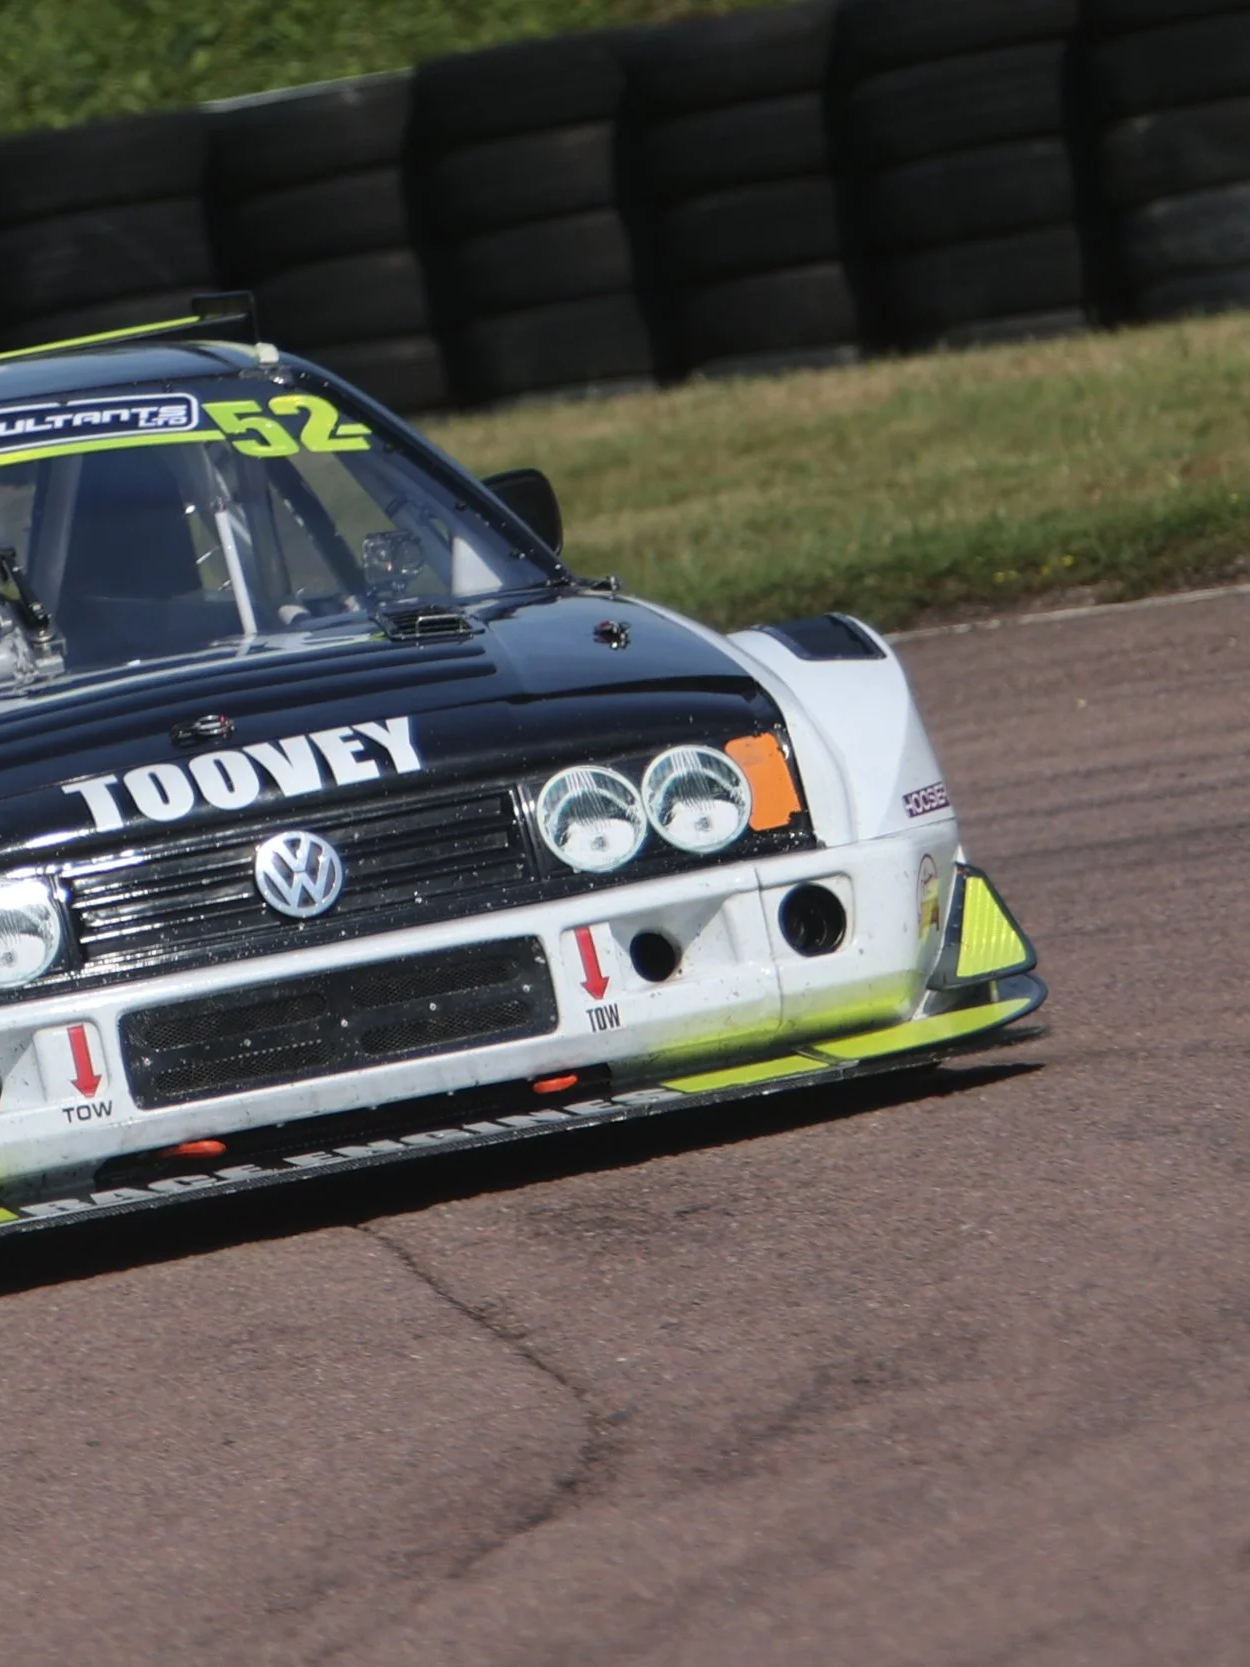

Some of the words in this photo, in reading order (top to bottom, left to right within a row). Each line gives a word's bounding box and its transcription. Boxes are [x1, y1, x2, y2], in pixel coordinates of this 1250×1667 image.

[202, 395, 373, 456] 52
[62, 716, 421, 832] TOOVEY
[586, 1001, 620, 1033] TOW
[62, 1100, 113, 1124] TOW
[19, 1164, 278, 1217] RACE
[283, 1088, 672, 1167] ENGINES
